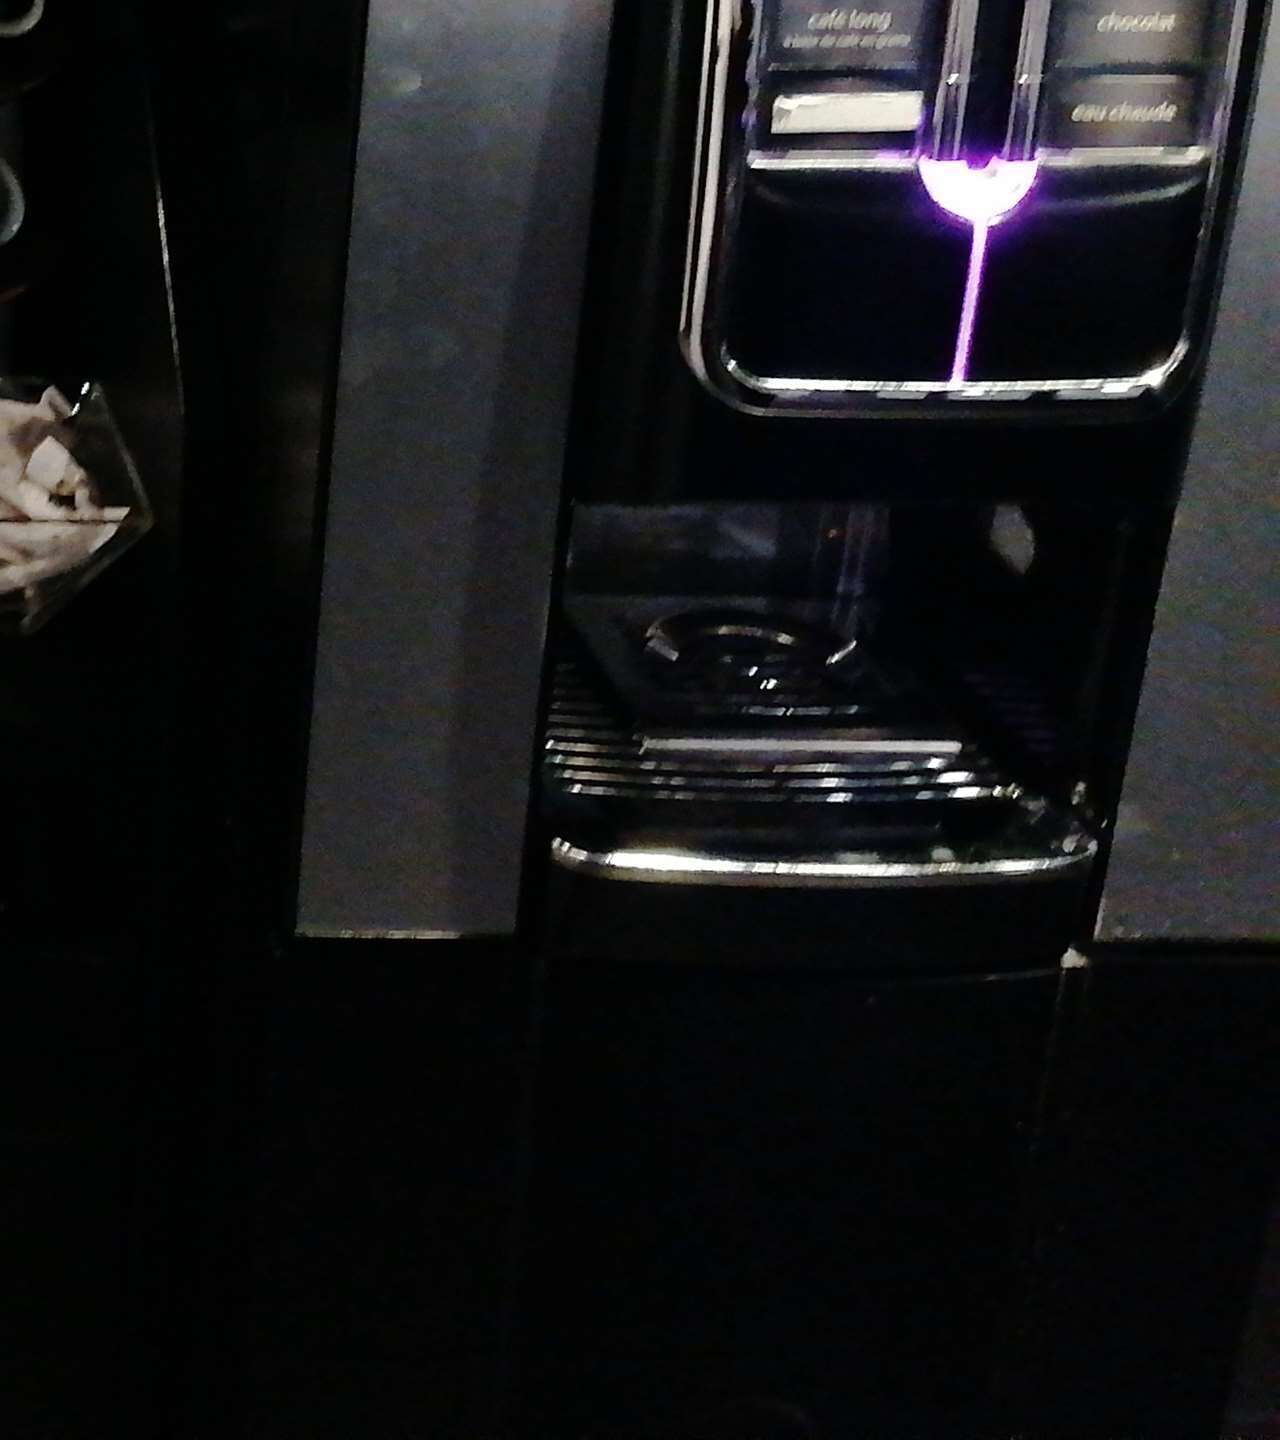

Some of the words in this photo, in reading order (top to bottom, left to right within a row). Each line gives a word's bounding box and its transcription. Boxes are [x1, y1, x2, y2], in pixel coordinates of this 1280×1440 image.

[807, 7, 848, 31] café
[848, 8, 893, 33] long
[1096, 12, 1177, 33] chocolat
[1071, 103, 1108, 122] eau
[1108, 100, 1179, 123] chaude
